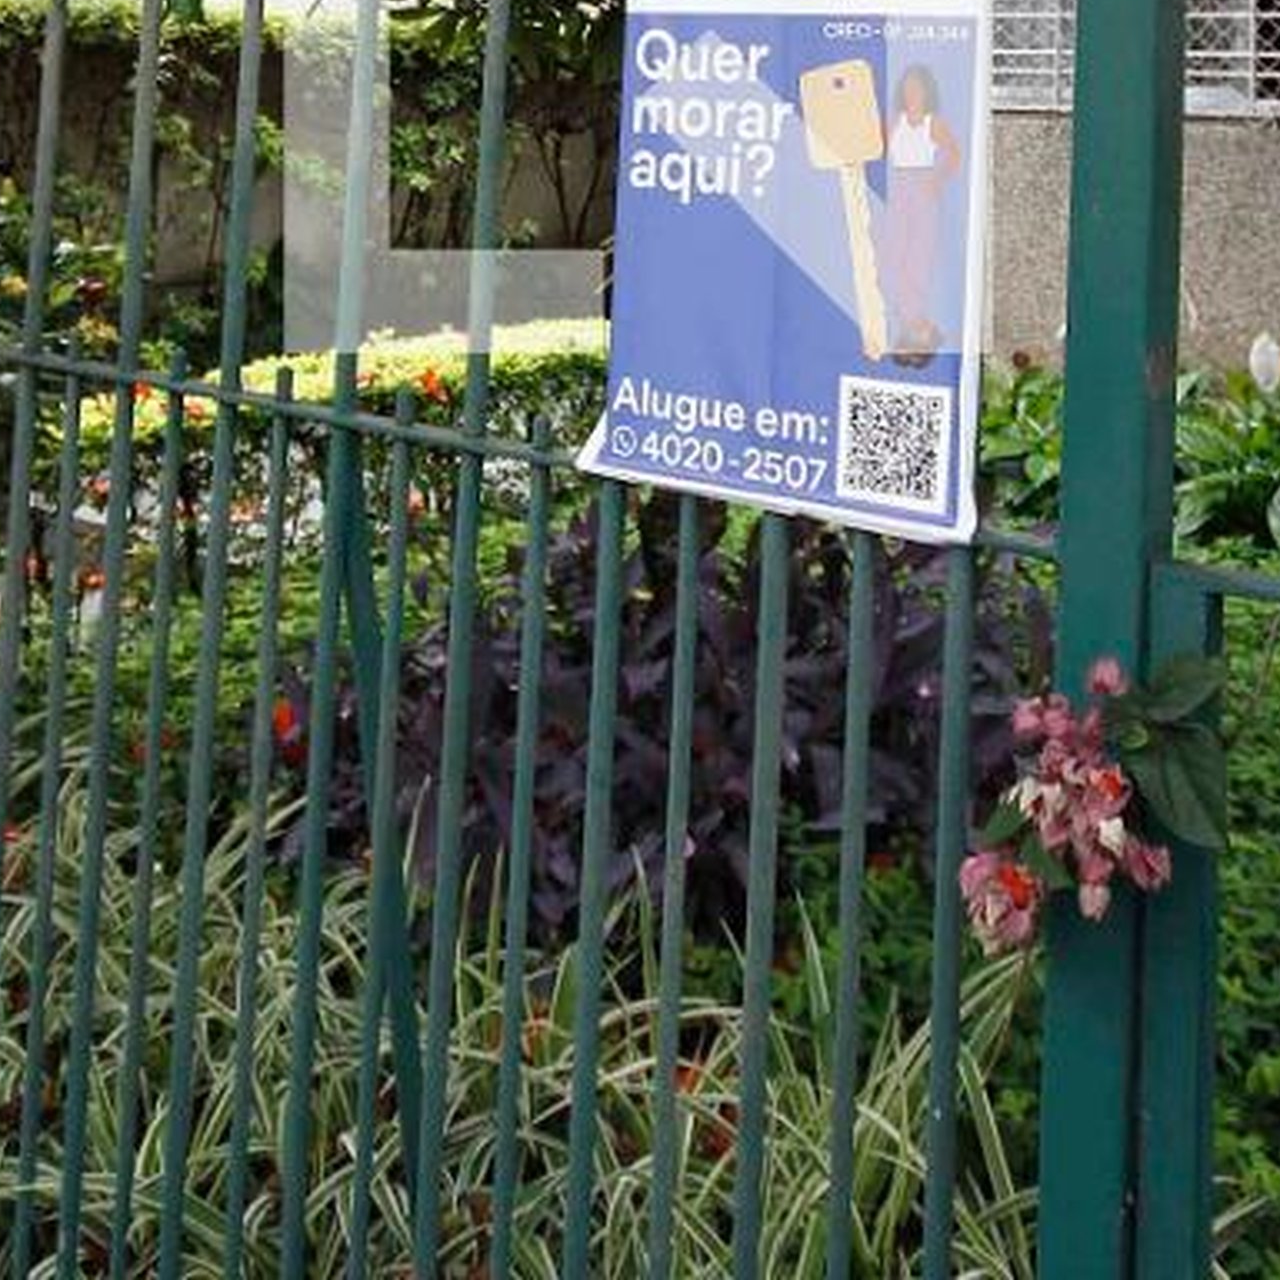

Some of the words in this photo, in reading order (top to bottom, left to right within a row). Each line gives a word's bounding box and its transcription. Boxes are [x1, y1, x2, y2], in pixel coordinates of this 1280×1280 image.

[635, 29, 770, 83] Quer
[632, 96, 795, 141] morar
[629, 146, 775, 204] aqui?
[613, 377, 745, 432] Alugue
[755, 409, 829, 445] em:
